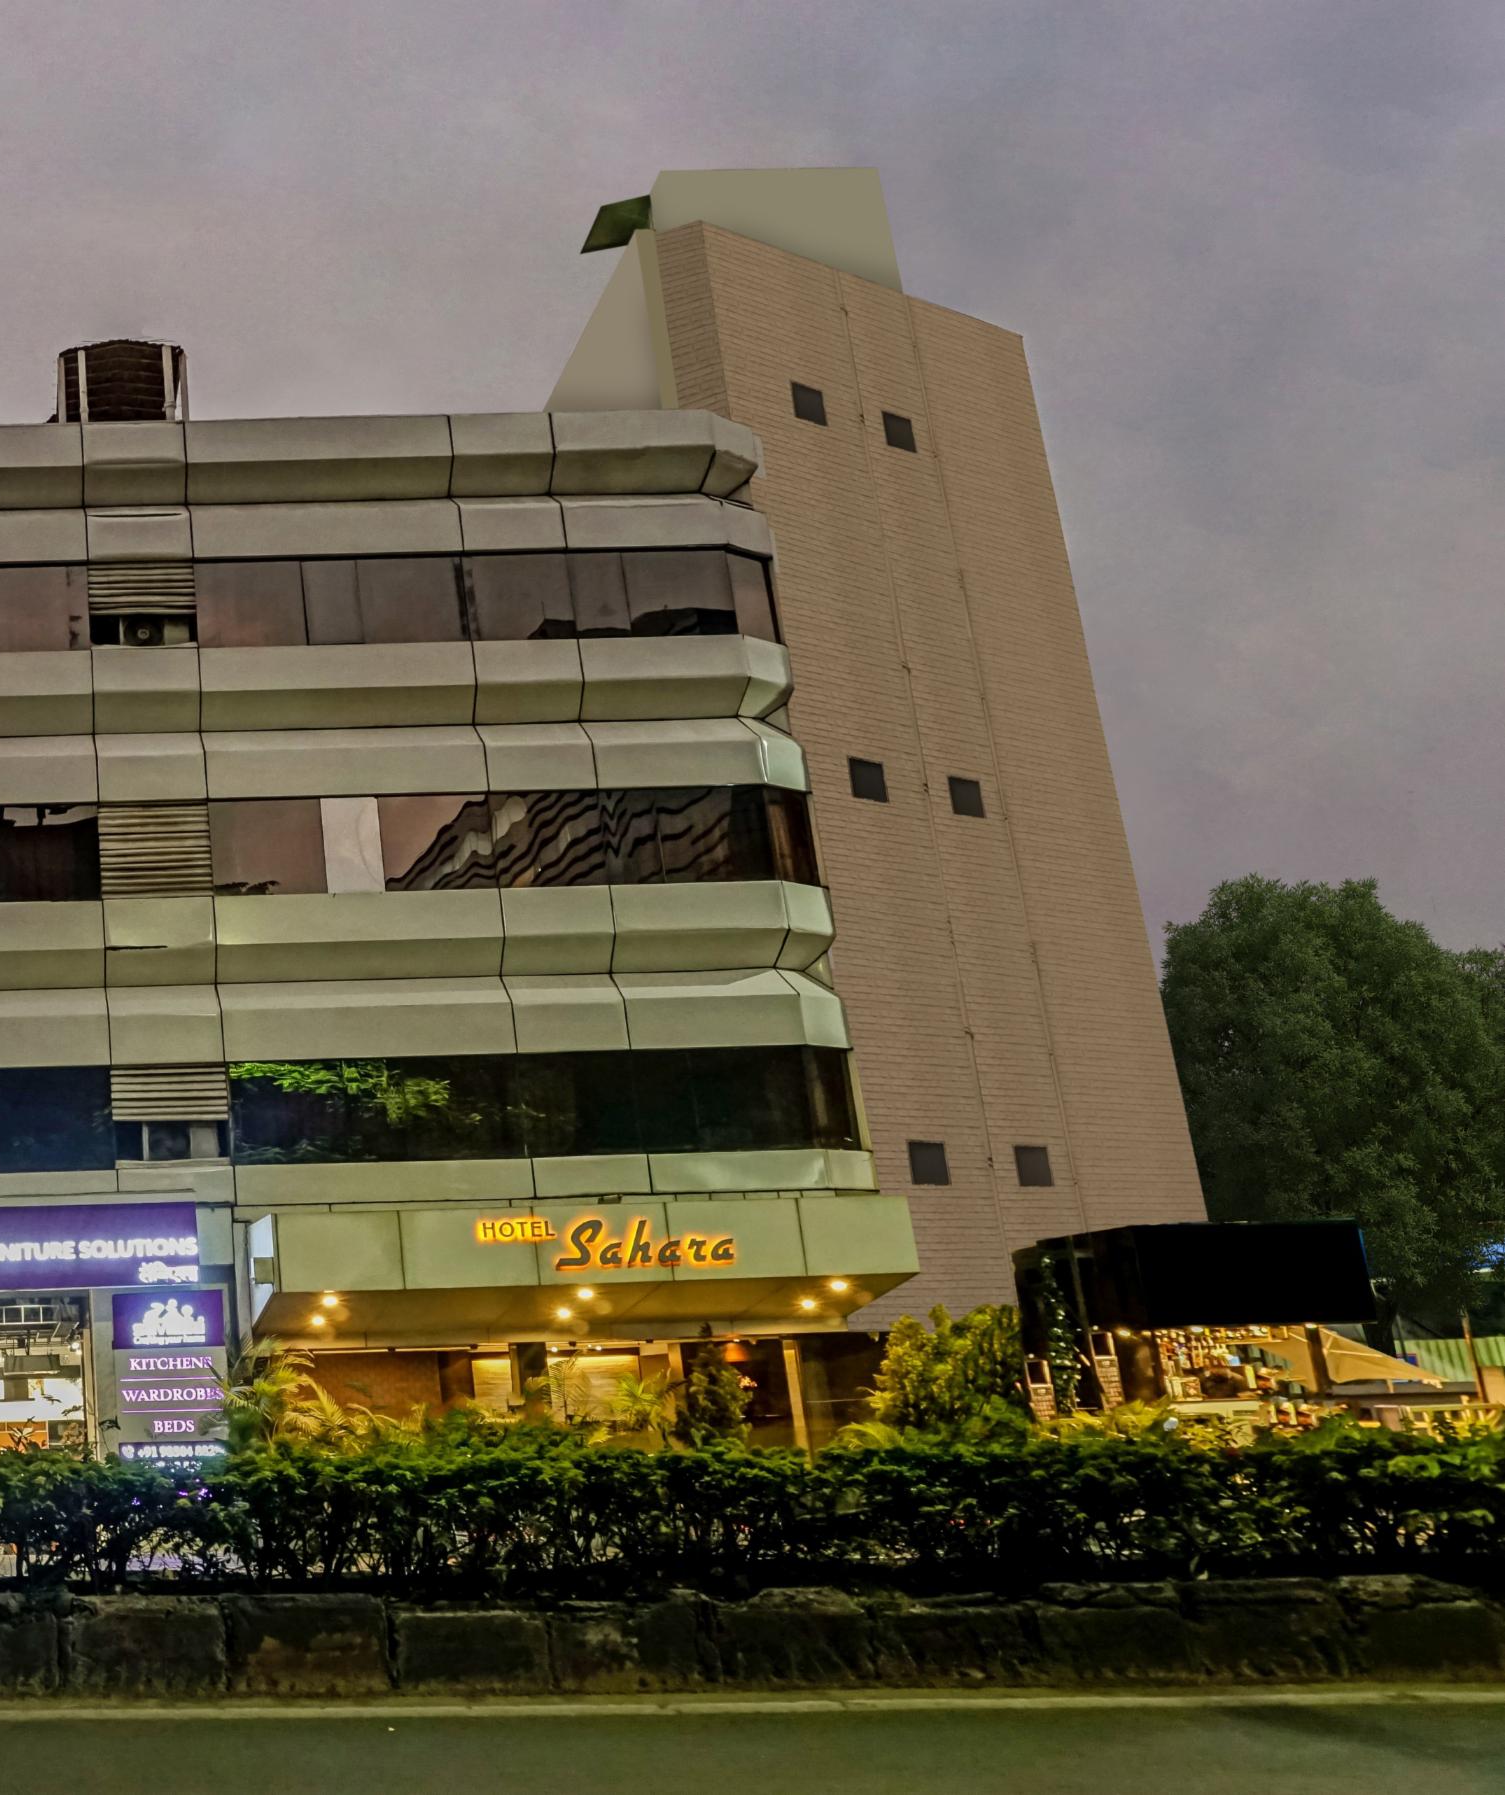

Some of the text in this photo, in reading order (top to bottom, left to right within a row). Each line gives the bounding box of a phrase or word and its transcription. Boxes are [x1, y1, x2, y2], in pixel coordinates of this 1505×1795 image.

[78, 1236, 199, 1260] SOLUTIONS
[482, 1219, 735, 1271] HOTEL Sahara
[129, 1356, 212, 1371] KITCHENS
[122, 1387, 224, 1402] WARDROBES
[153, 1420, 195, 1433] BEDS
